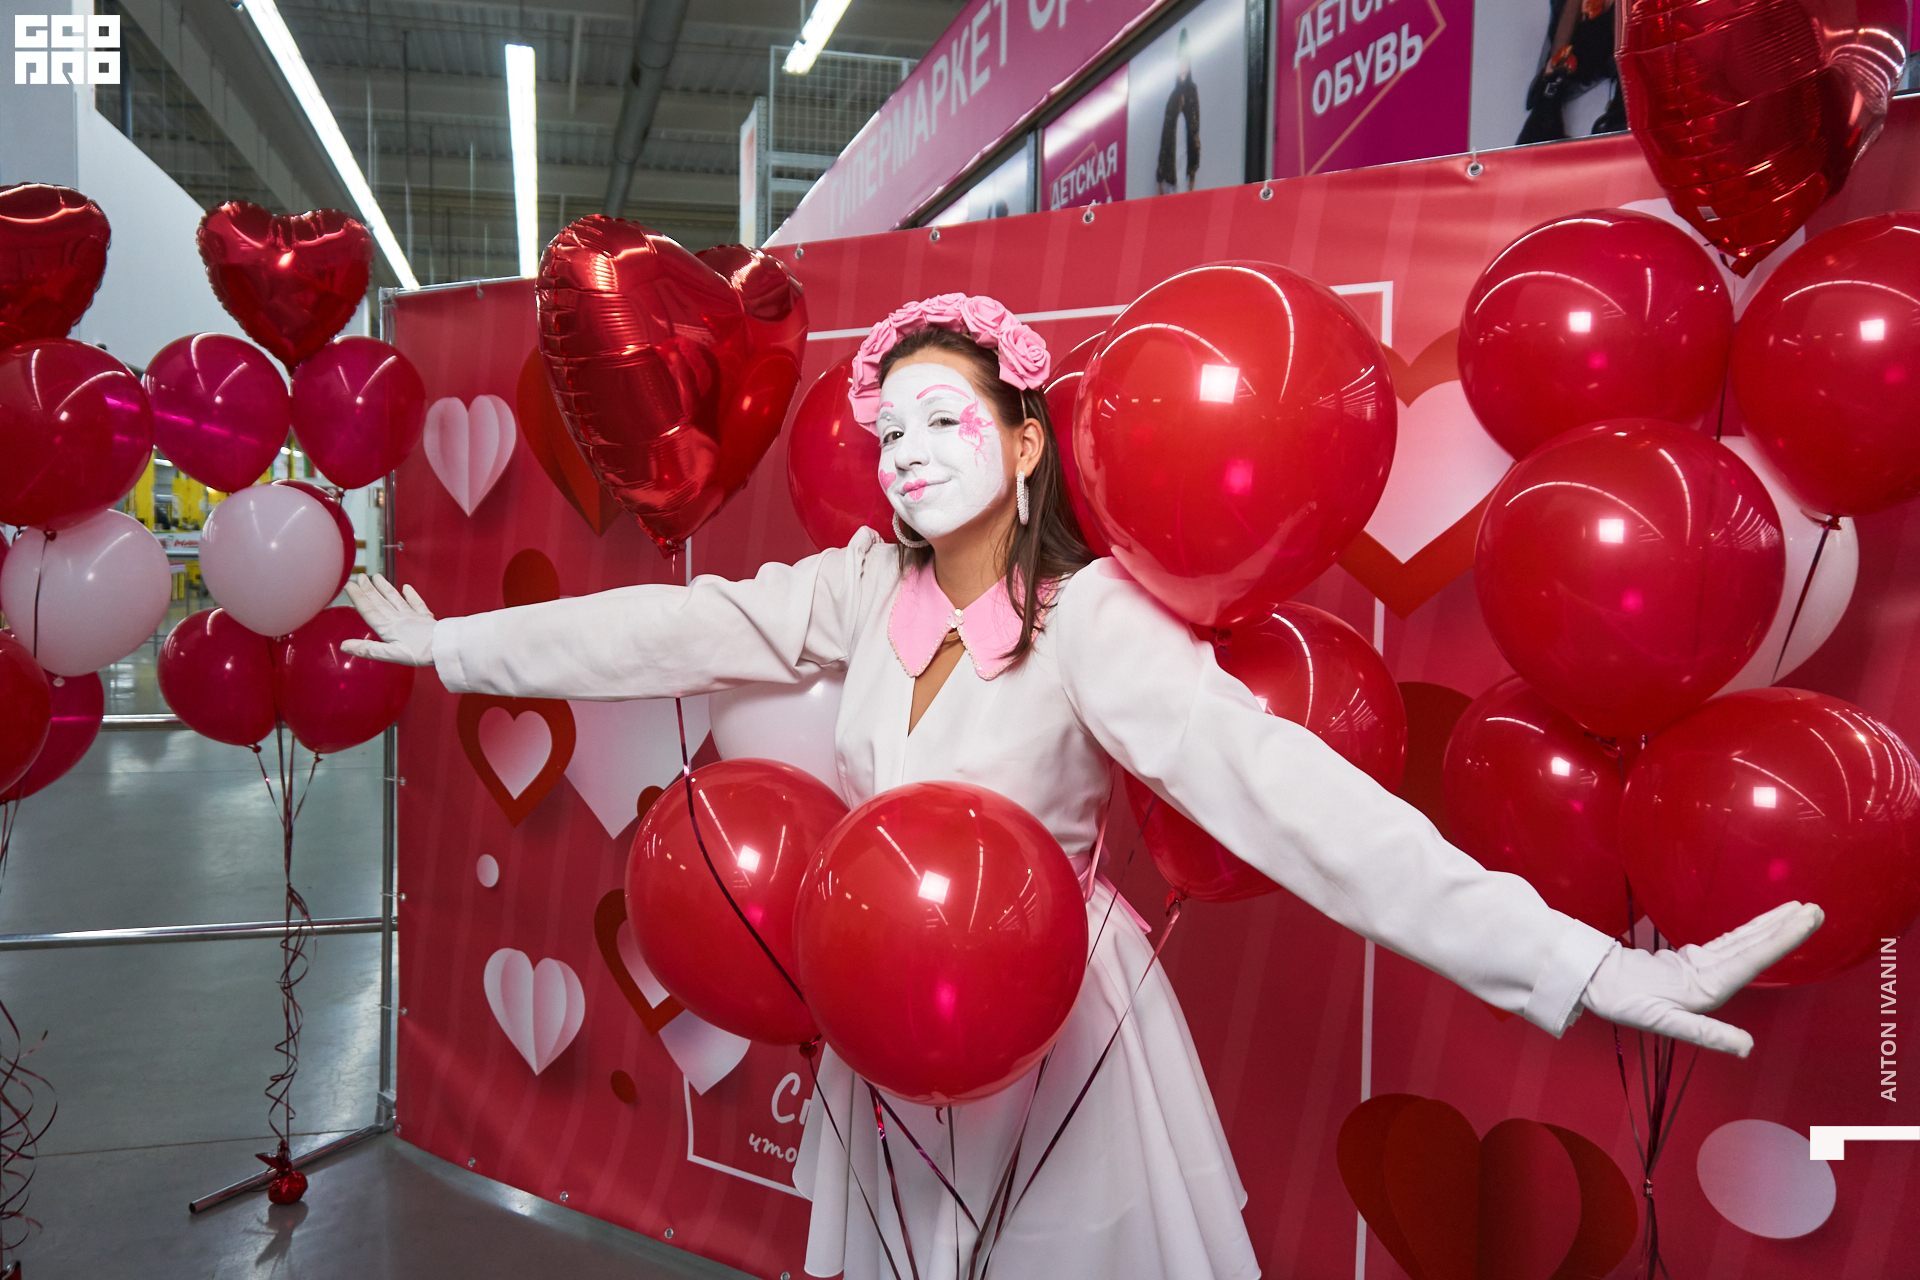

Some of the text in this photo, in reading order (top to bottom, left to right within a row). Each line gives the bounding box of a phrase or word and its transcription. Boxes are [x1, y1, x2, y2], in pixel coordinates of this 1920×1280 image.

[1312, 23, 1424, 115] ОБУВЬ
[830, 0, 1008, 233] ГИПЕРМАРКЕТ
[1050, 141, 1118, 211] ДЕТСКАЯ
